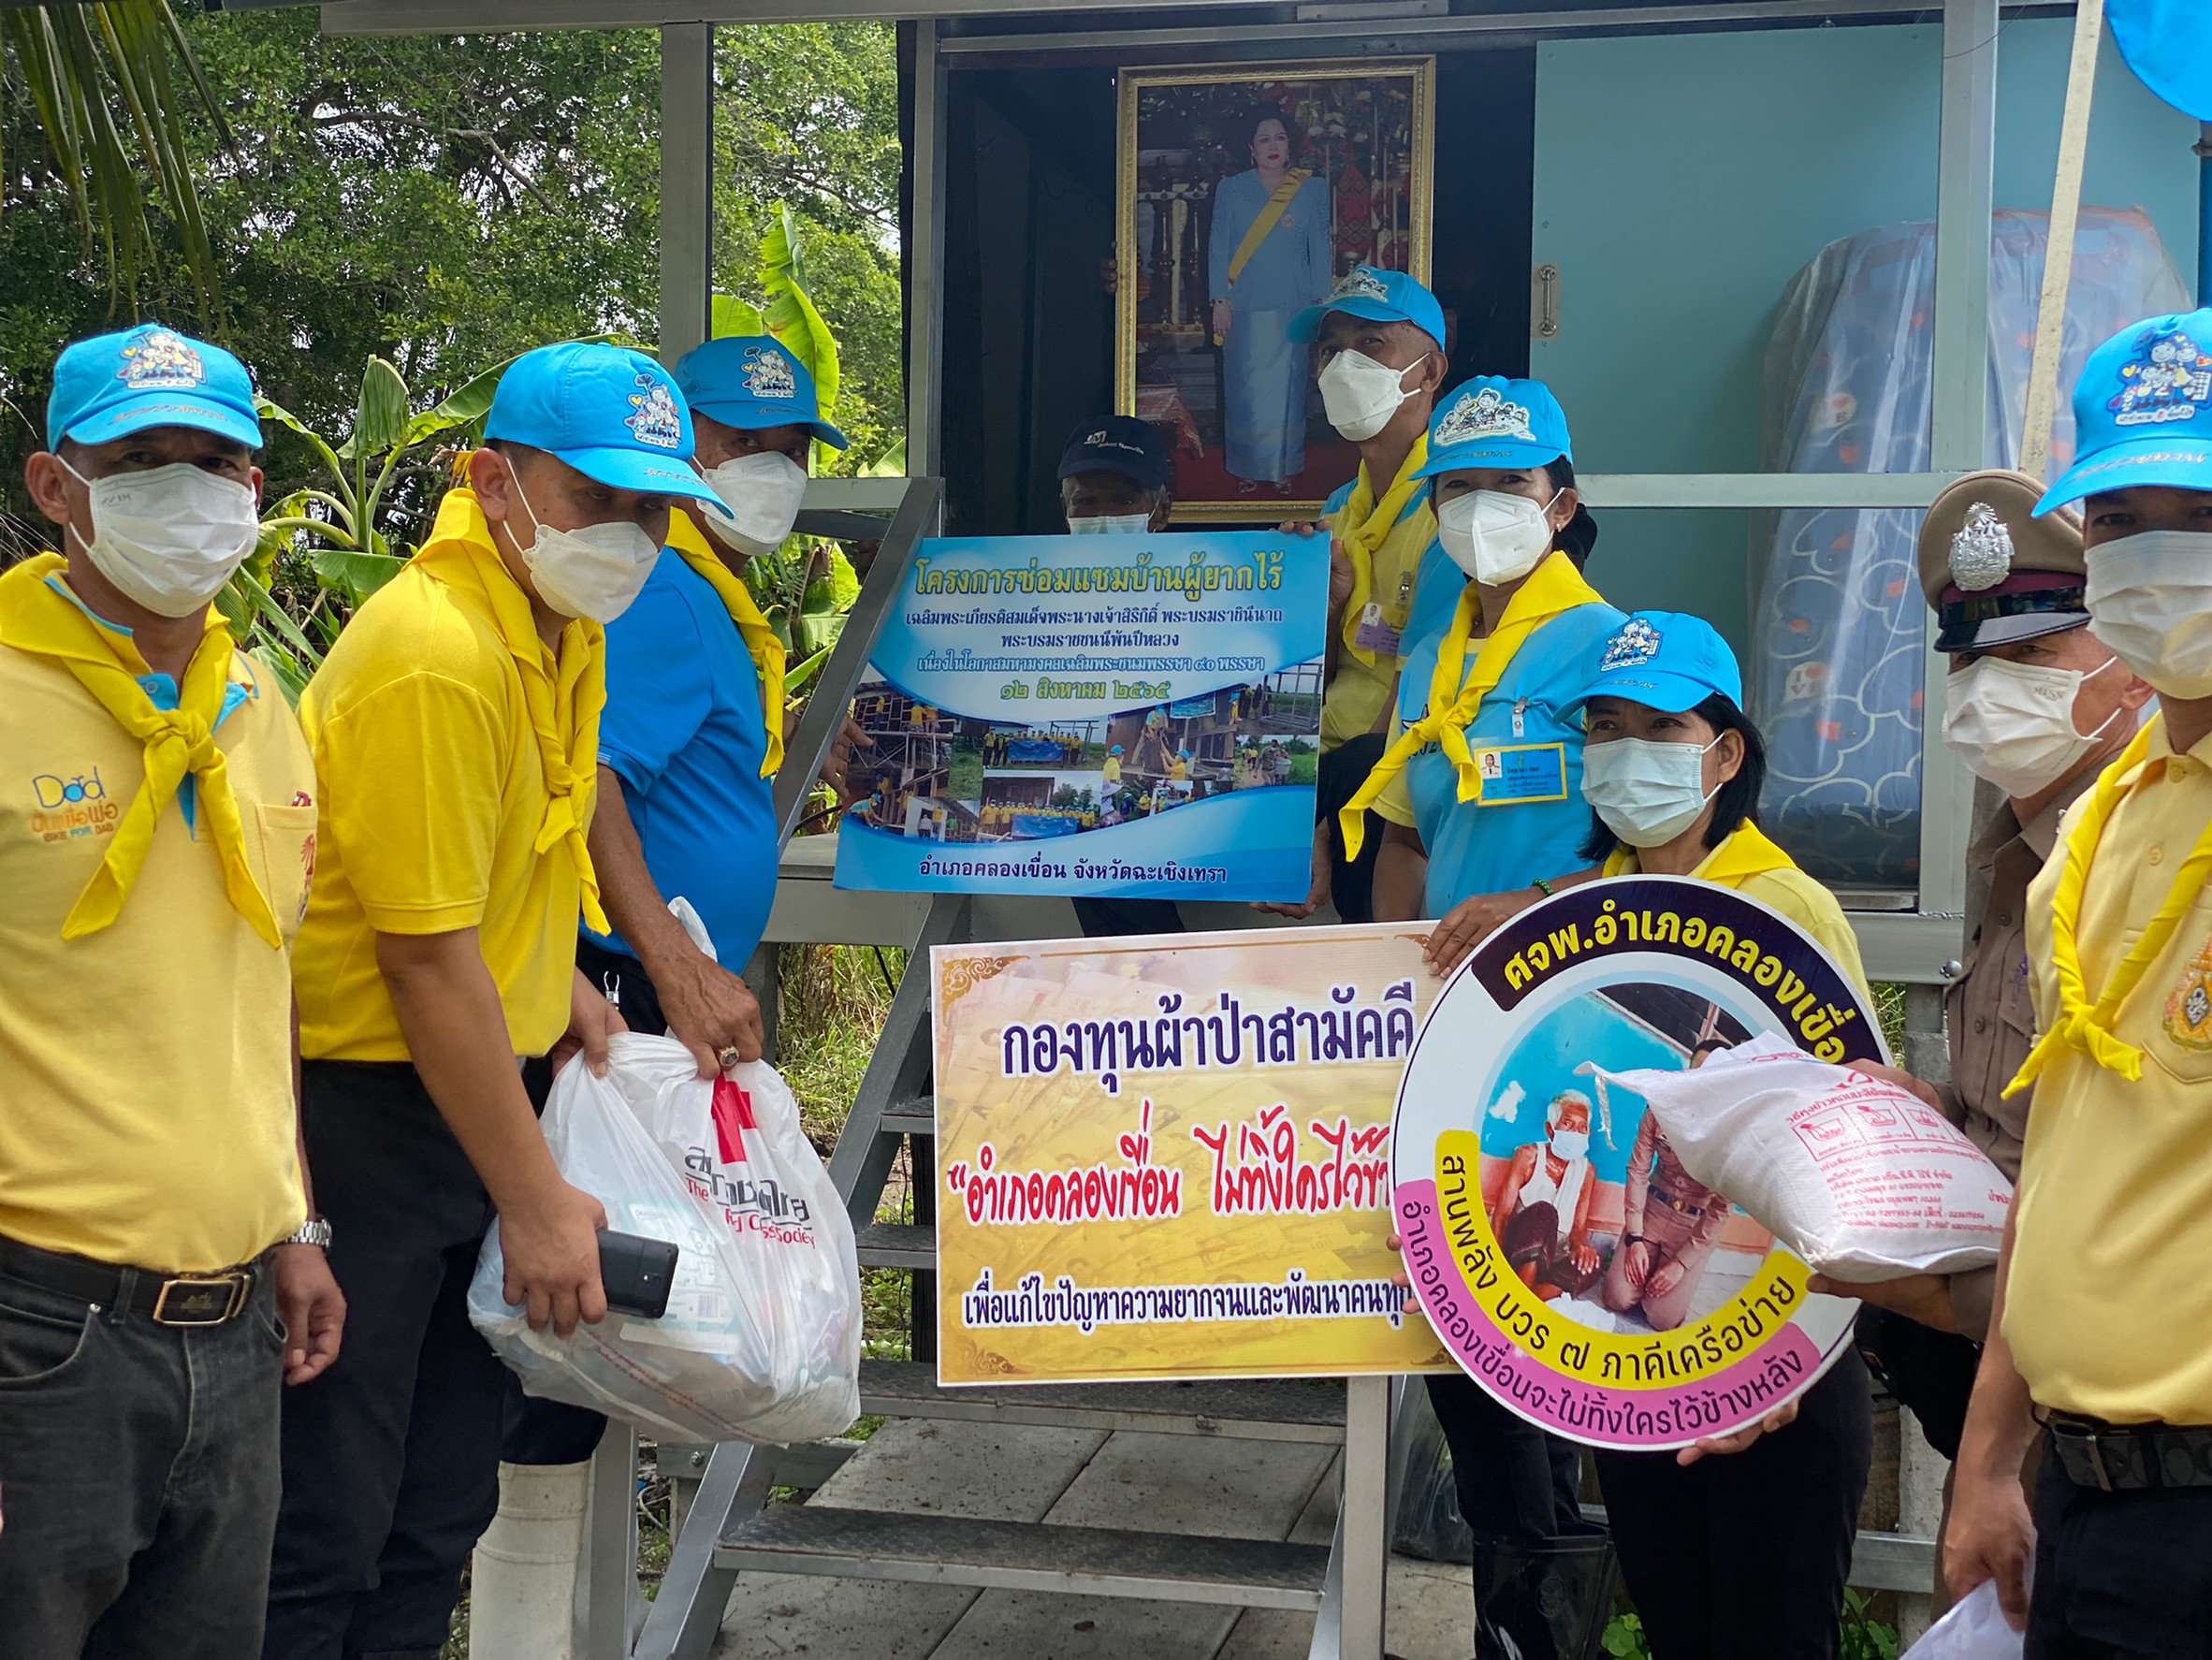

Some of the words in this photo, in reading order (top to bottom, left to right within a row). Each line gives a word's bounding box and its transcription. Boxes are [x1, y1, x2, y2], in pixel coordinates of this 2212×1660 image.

[914, 550, 1285, 601] โครงการซ่อมแซมบ้านผู้ยากไร้
[1162, 606, 1283, 625] พระบรมราชินีนาถ
[1000, 630, 1180, 648] พระบรมราชชนนีพันปีหลวง
[1194, 656, 1216, 672] ๙๐
[1217, 656, 1265, 672] พรรษา
[999, 681, 1028, 700] ๑๒
[1036, 676, 1106, 700] สิงหาคม
[1113, 679, 1171, 700] ๒๕๖๕
[919, 852, 1067, 879] อำเภอคลองเขื่อน
[1073, 858, 1228, 883] จังหวัดฉะเชิงเทรา
[1002, 982, 1414, 1093] กองทุนผ้าป่าสามัคคี
[686, 1176, 709, 1201] The
[1442, 1155, 1497, 1289] สานพลัง
[1496, 1291, 1550, 1350] บวร
[1602, 1275, 1797, 1382] ภาคีเครือข่าย
